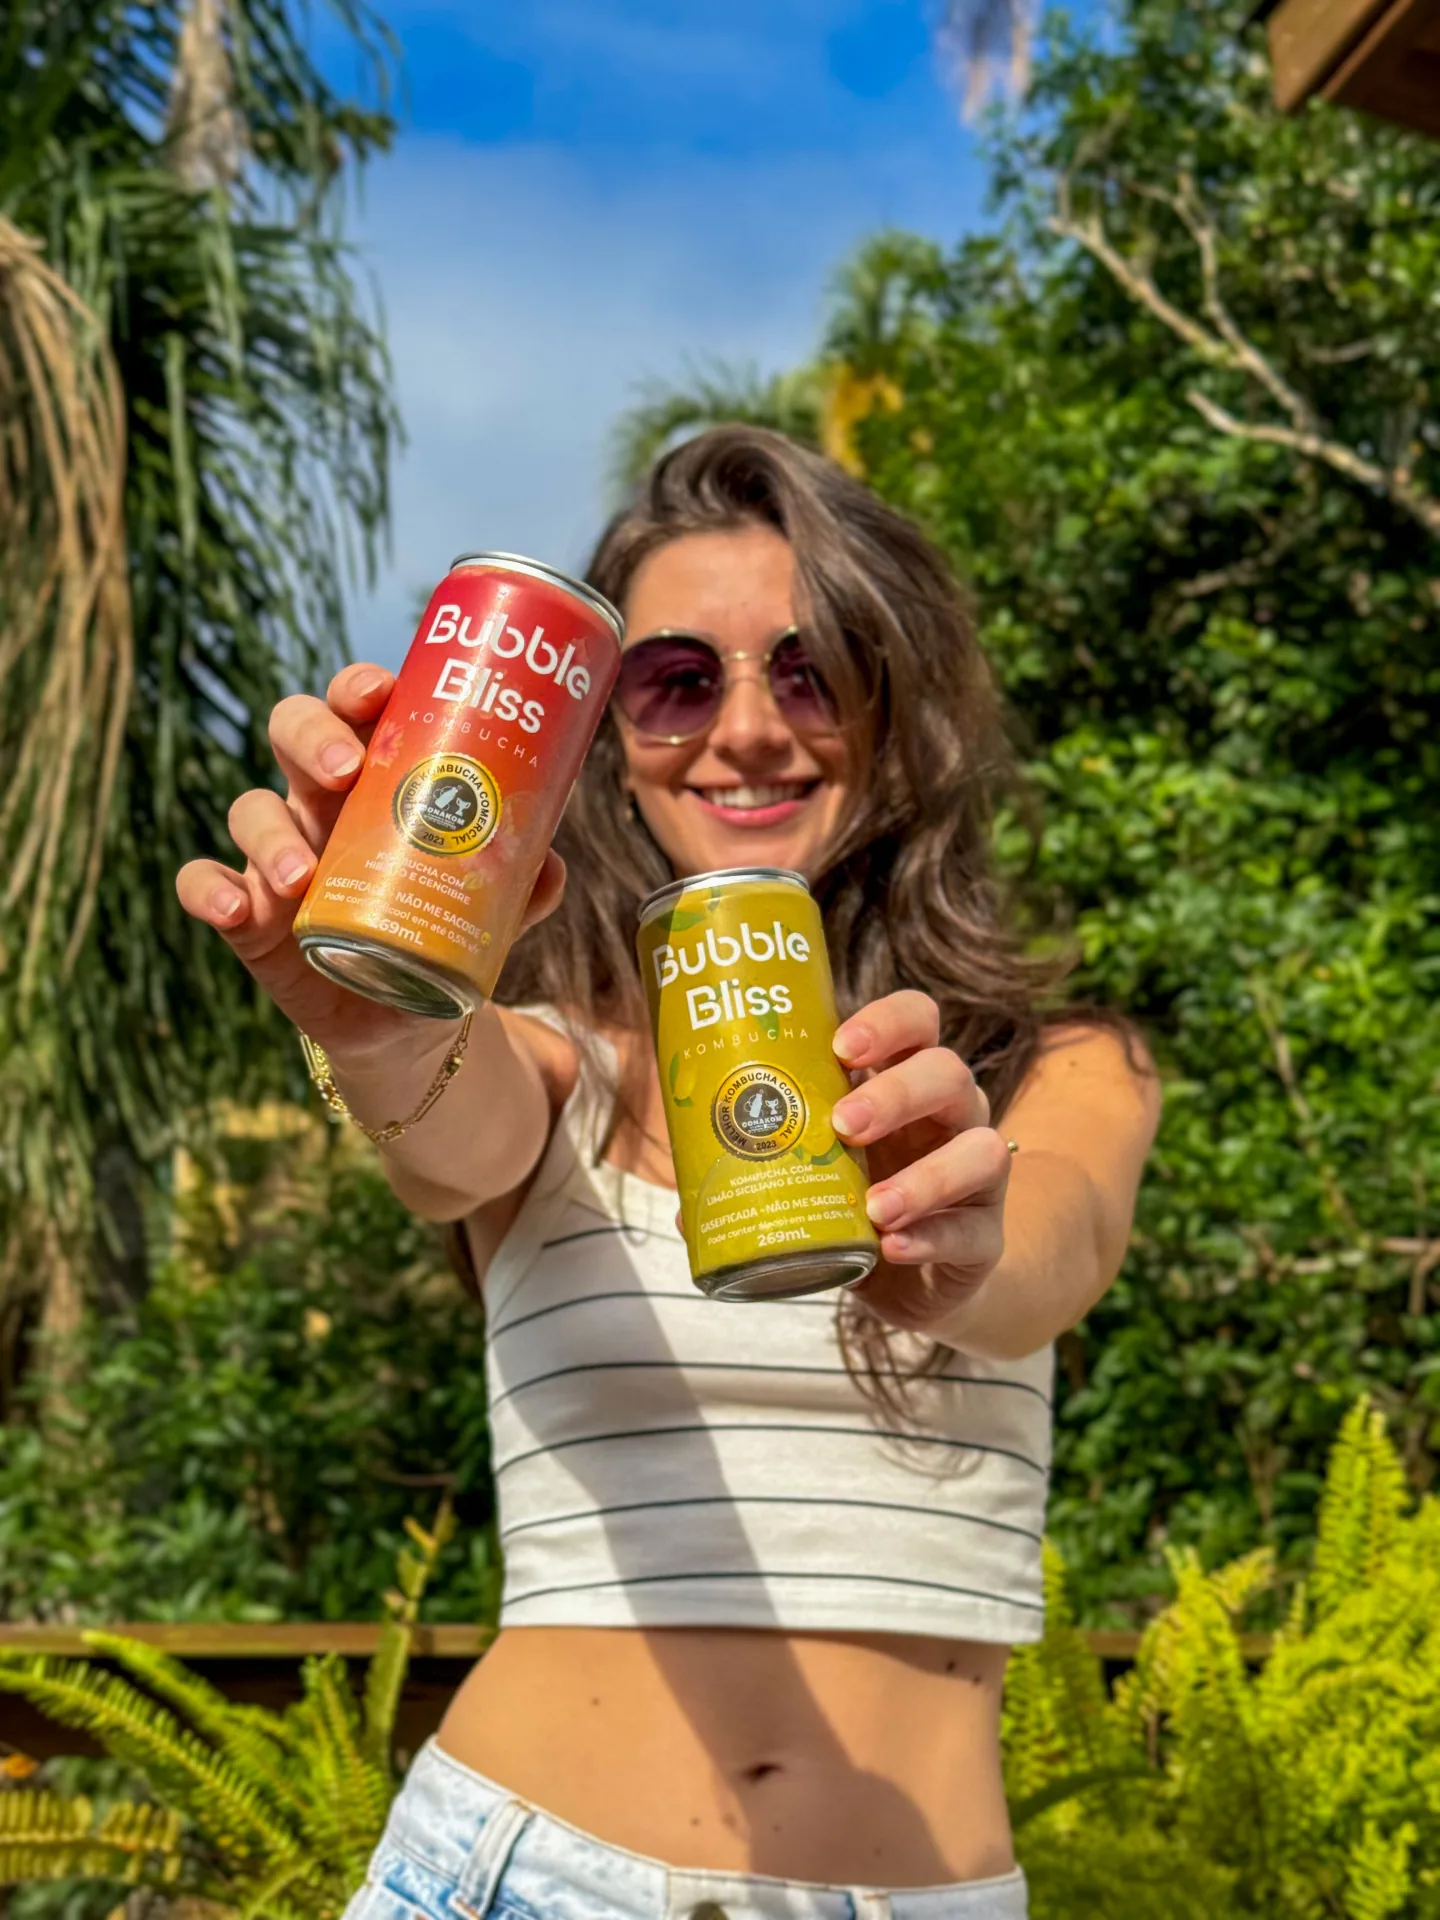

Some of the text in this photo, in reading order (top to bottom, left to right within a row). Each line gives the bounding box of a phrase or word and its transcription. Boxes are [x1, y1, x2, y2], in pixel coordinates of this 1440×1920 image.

[425, 604, 590, 699] Bubble
[432, 658, 545, 734] Bliss
[409, 710, 538, 768] KOMBUCHA
[418, 803, 466, 826] ONAKOM
[420, 764, 483, 791] KOMBUCHA
[452, 791, 490, 845] COMERCIAL
[423, 832, 445, 846] 2023
[409, 872, 420, 881] E
[418, 873, 471, 905] GENGIBRE
[440, 872, 465, 890] COM
[323, 892, 345, 902] Pode
[412, 914, 428, 928] em
[431, 922, 446, 936] até
[395, 891, 422, 909] NÃO
[423, 902, 441, 918] ME
[442, 910, 481, 938] SACODE
[652, 921, 810, 989] Bubble
[686, 978, 793, 1031] Bliss
[684, 1028, 808, 1060] KOMBUCHA
[722, 1072, 799, 1147] MELHOR KOMBUCHA COMERCIAL
[742, 1115, 783, 1128] CONAKOM
[756, 1140, 777, 1151] 2023
[706, 1173, 840, 1206] LIMÃO SICILIANO E CÚRCUMA
[730, 1164, 813, 1187] KOMBUCHA COM
[701, 1207, 758, 1234] GASEIFICADA
[766, 1200, 790, 1214] NÃO
[792, 1196, 809, 1209] ME
[810, 1194, 847, 1206] SACODE
[707, 1234, 726, 1246] Pode
[727, 1225, 756, 1239] conter
[789, 1216, 804, 1225] em
[807, 1213, 822, 1222] até
[758, 1228, 811, 1248] 269mL
